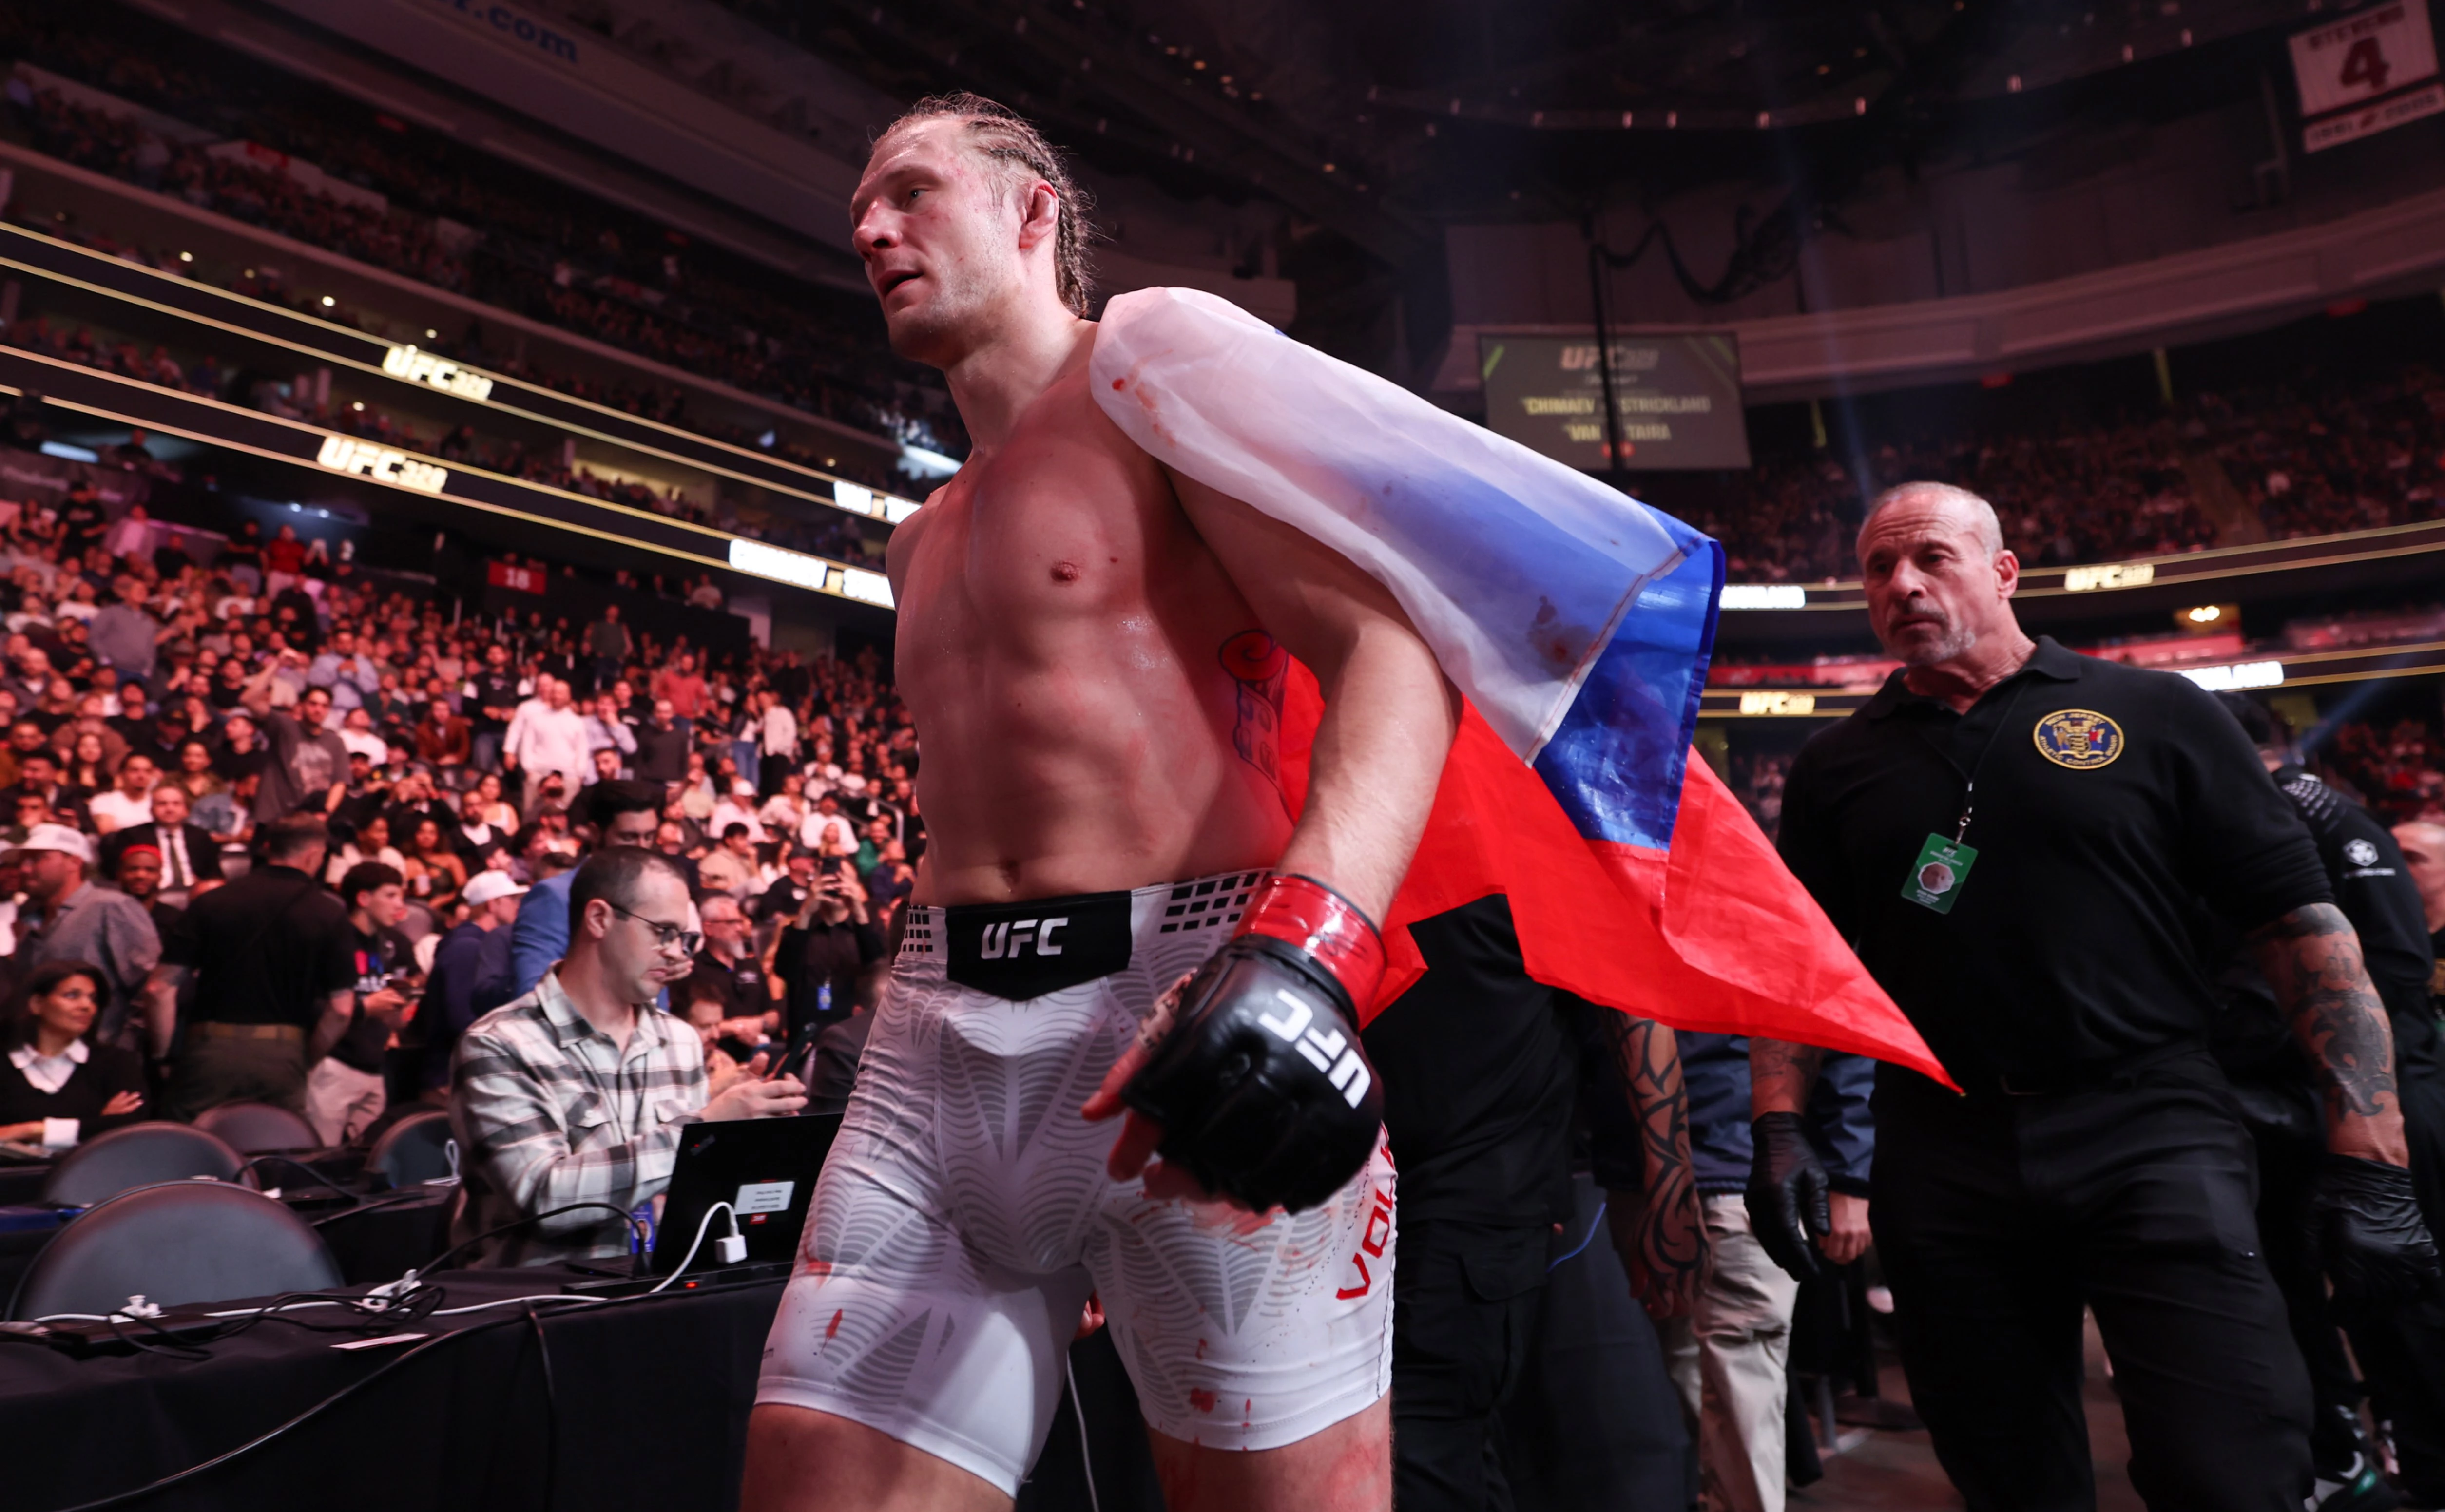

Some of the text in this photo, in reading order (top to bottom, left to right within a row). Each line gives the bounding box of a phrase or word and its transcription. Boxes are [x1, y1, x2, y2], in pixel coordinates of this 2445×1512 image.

[2340, 37, 2389, 88] 4
[317, 435, 406, 483] UFC
[981, 917, 1069, 960] UFC
[1257, 988, 1371, 1109] UFC
